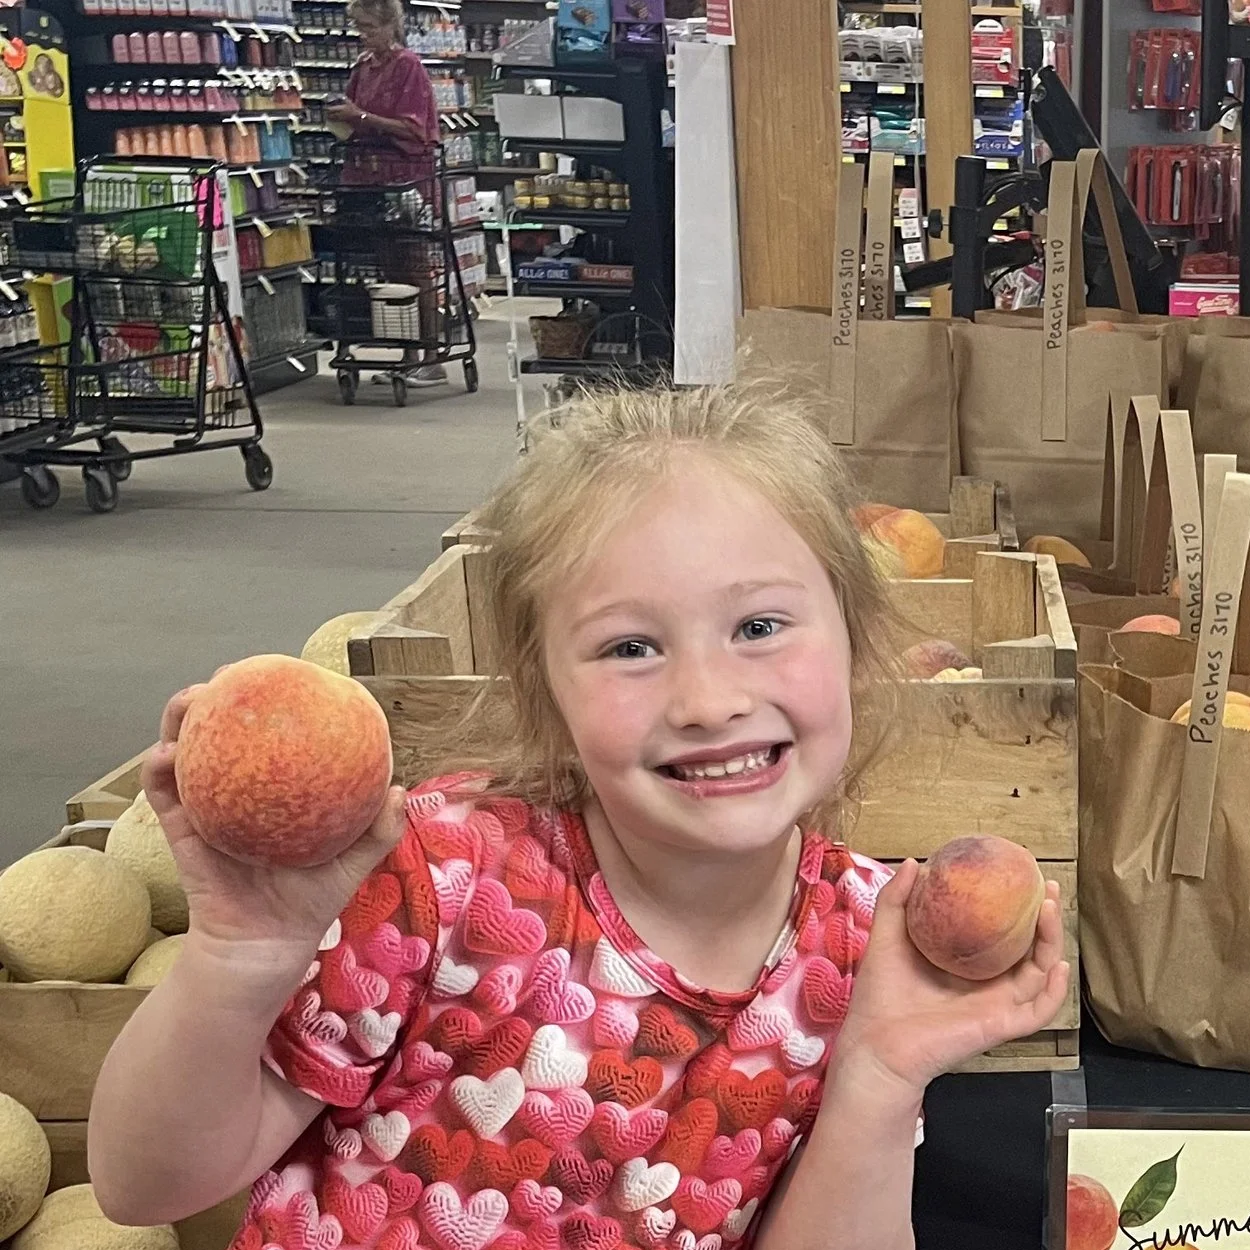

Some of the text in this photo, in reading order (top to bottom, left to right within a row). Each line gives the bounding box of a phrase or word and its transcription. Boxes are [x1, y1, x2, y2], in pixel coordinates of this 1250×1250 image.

[833, 249, 854, 346] Peaches 3170
[870, 242, 884, 320] ches 3170
[1047, 239, 1065, 349] Peaches 3170
[1181, 522, 1201, 635] aches 3170
[1189, 592, 1233, 743] Peaches 3170
